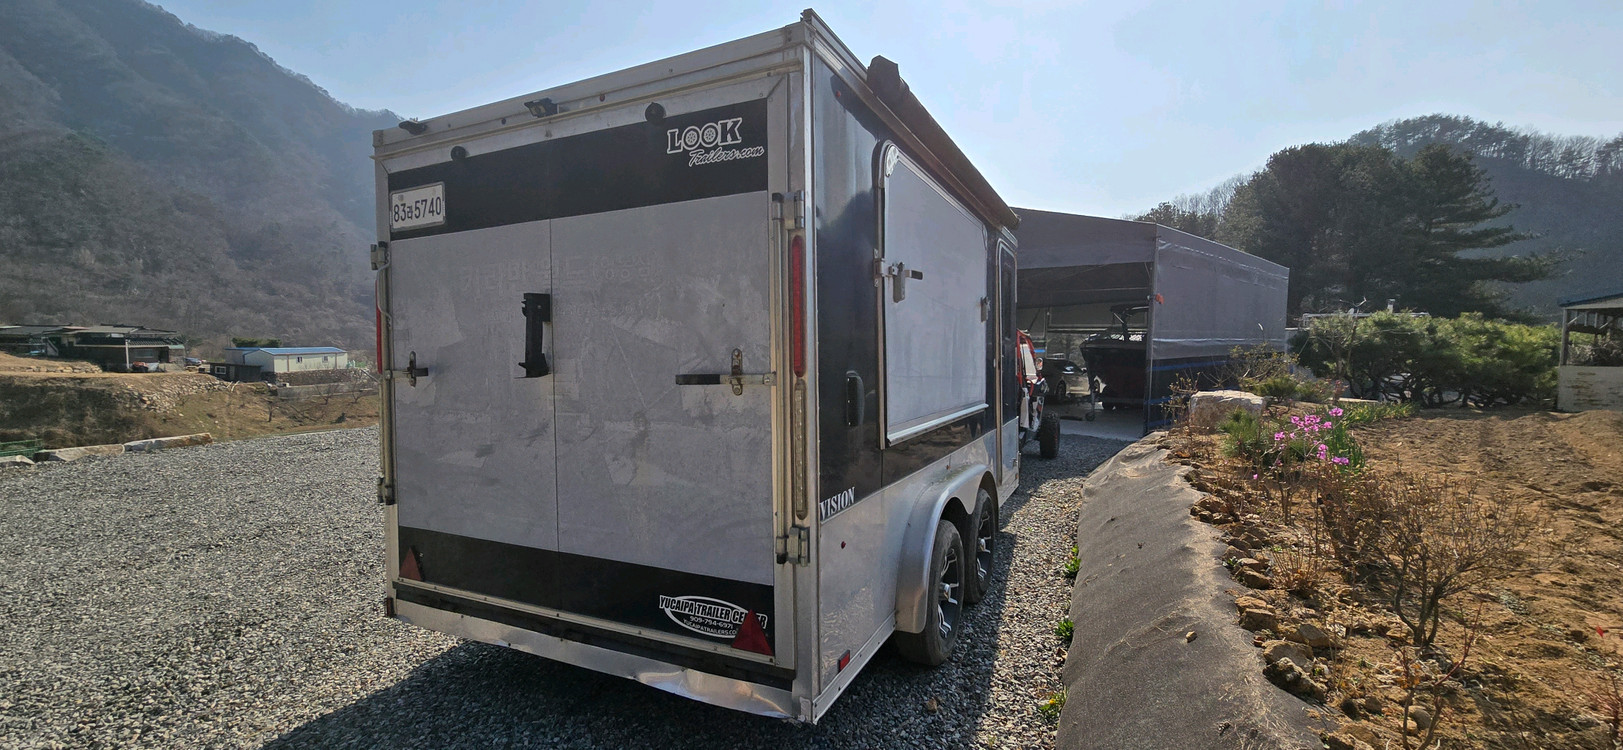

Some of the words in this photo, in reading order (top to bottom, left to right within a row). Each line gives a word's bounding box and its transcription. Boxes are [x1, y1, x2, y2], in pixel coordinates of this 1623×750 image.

[666, 117, 743, 154] LOOK
[688, 145, 765, 167] Trailers.com
[393, 196, 442, 222] 83라5740
[819, 486, 855, 520] VISION
[659, 594, 695, 614] YUCAIPA
[695, 602, 732, 622] TRAILER
[683, 618, 737, 635] YUCAIPATRAILERS.CO
